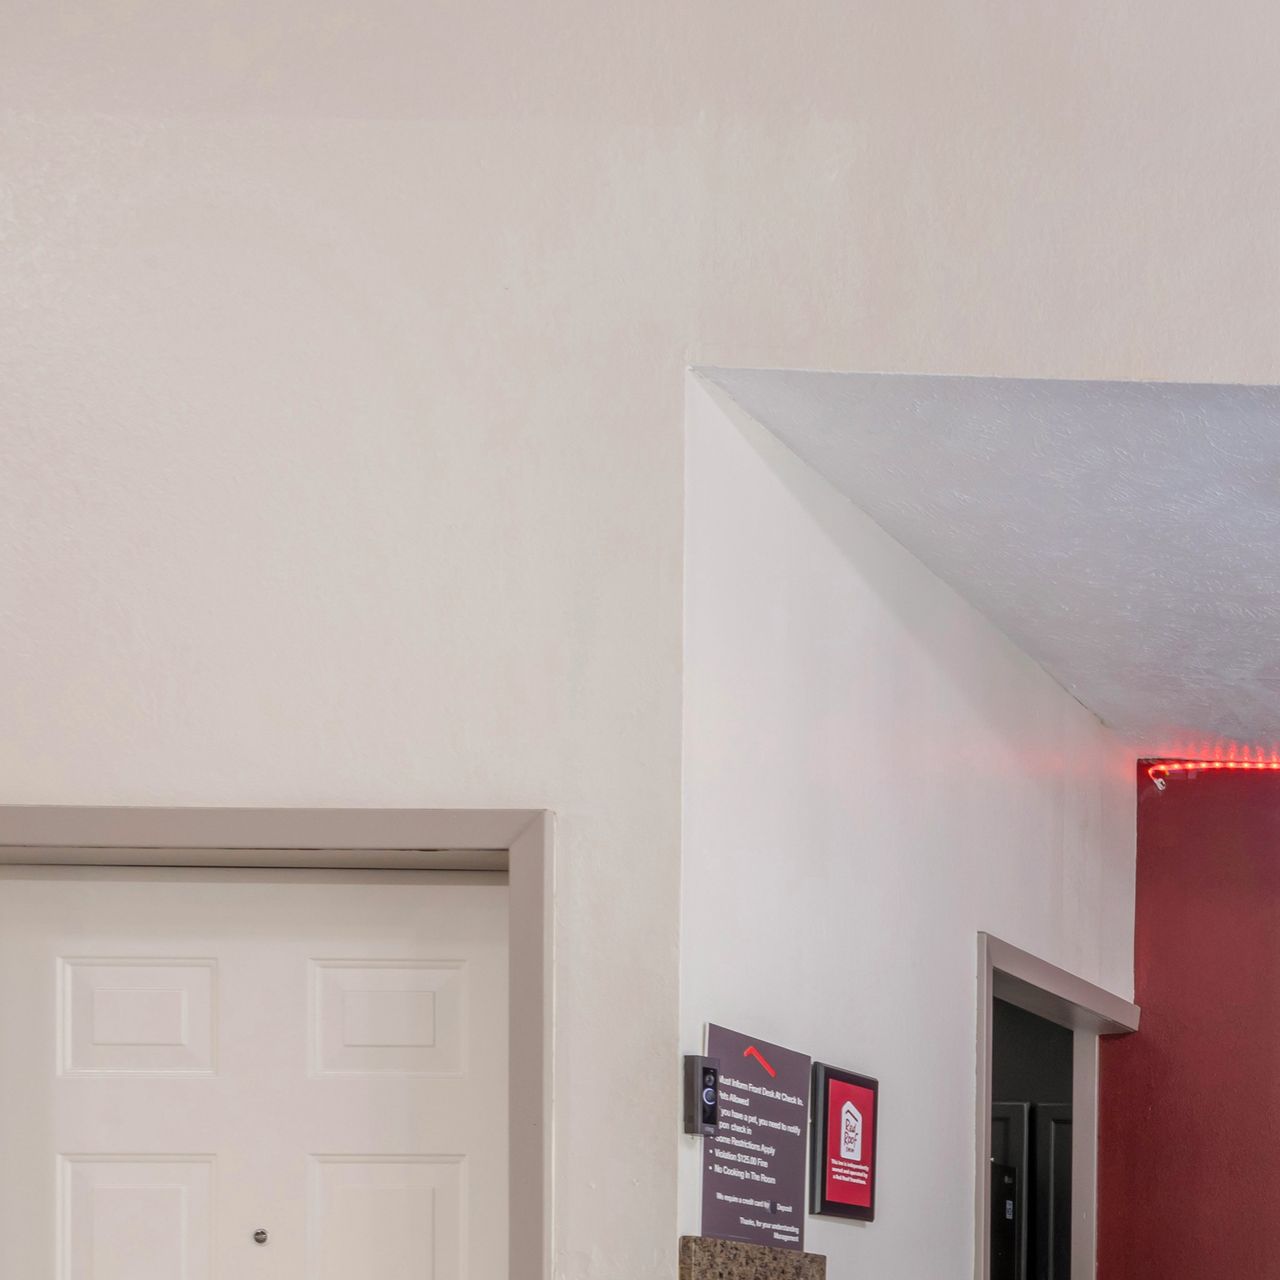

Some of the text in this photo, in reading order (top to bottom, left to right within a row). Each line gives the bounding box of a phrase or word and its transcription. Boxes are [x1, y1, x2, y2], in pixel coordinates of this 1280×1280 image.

[730, 1093, 750, 1106] Allowed
[748, 1084, 762, 1094] Front
[782, 1093, 797, 1104] Check
[731, 1122, 746, 1134] check
[732, 1109, 743, 1120] have
[758, 1118, 768, 1126] you
[769, 1120, 781, 1130] need
[782, 1122, 786, 1131] to
[787, 1124, 800, 1136] notify
[714, 1148, 737, 1161] Violation
[758, 1158, 768, 1168] Fine
[761, 1144, 776, 1156] Apply
[714, 1164, 722, 1174] No
[723, 1166, 744, 1180] Cooking
[751, 1172, 760, 1182] The
[761, 1174, 776, 1184] Room
